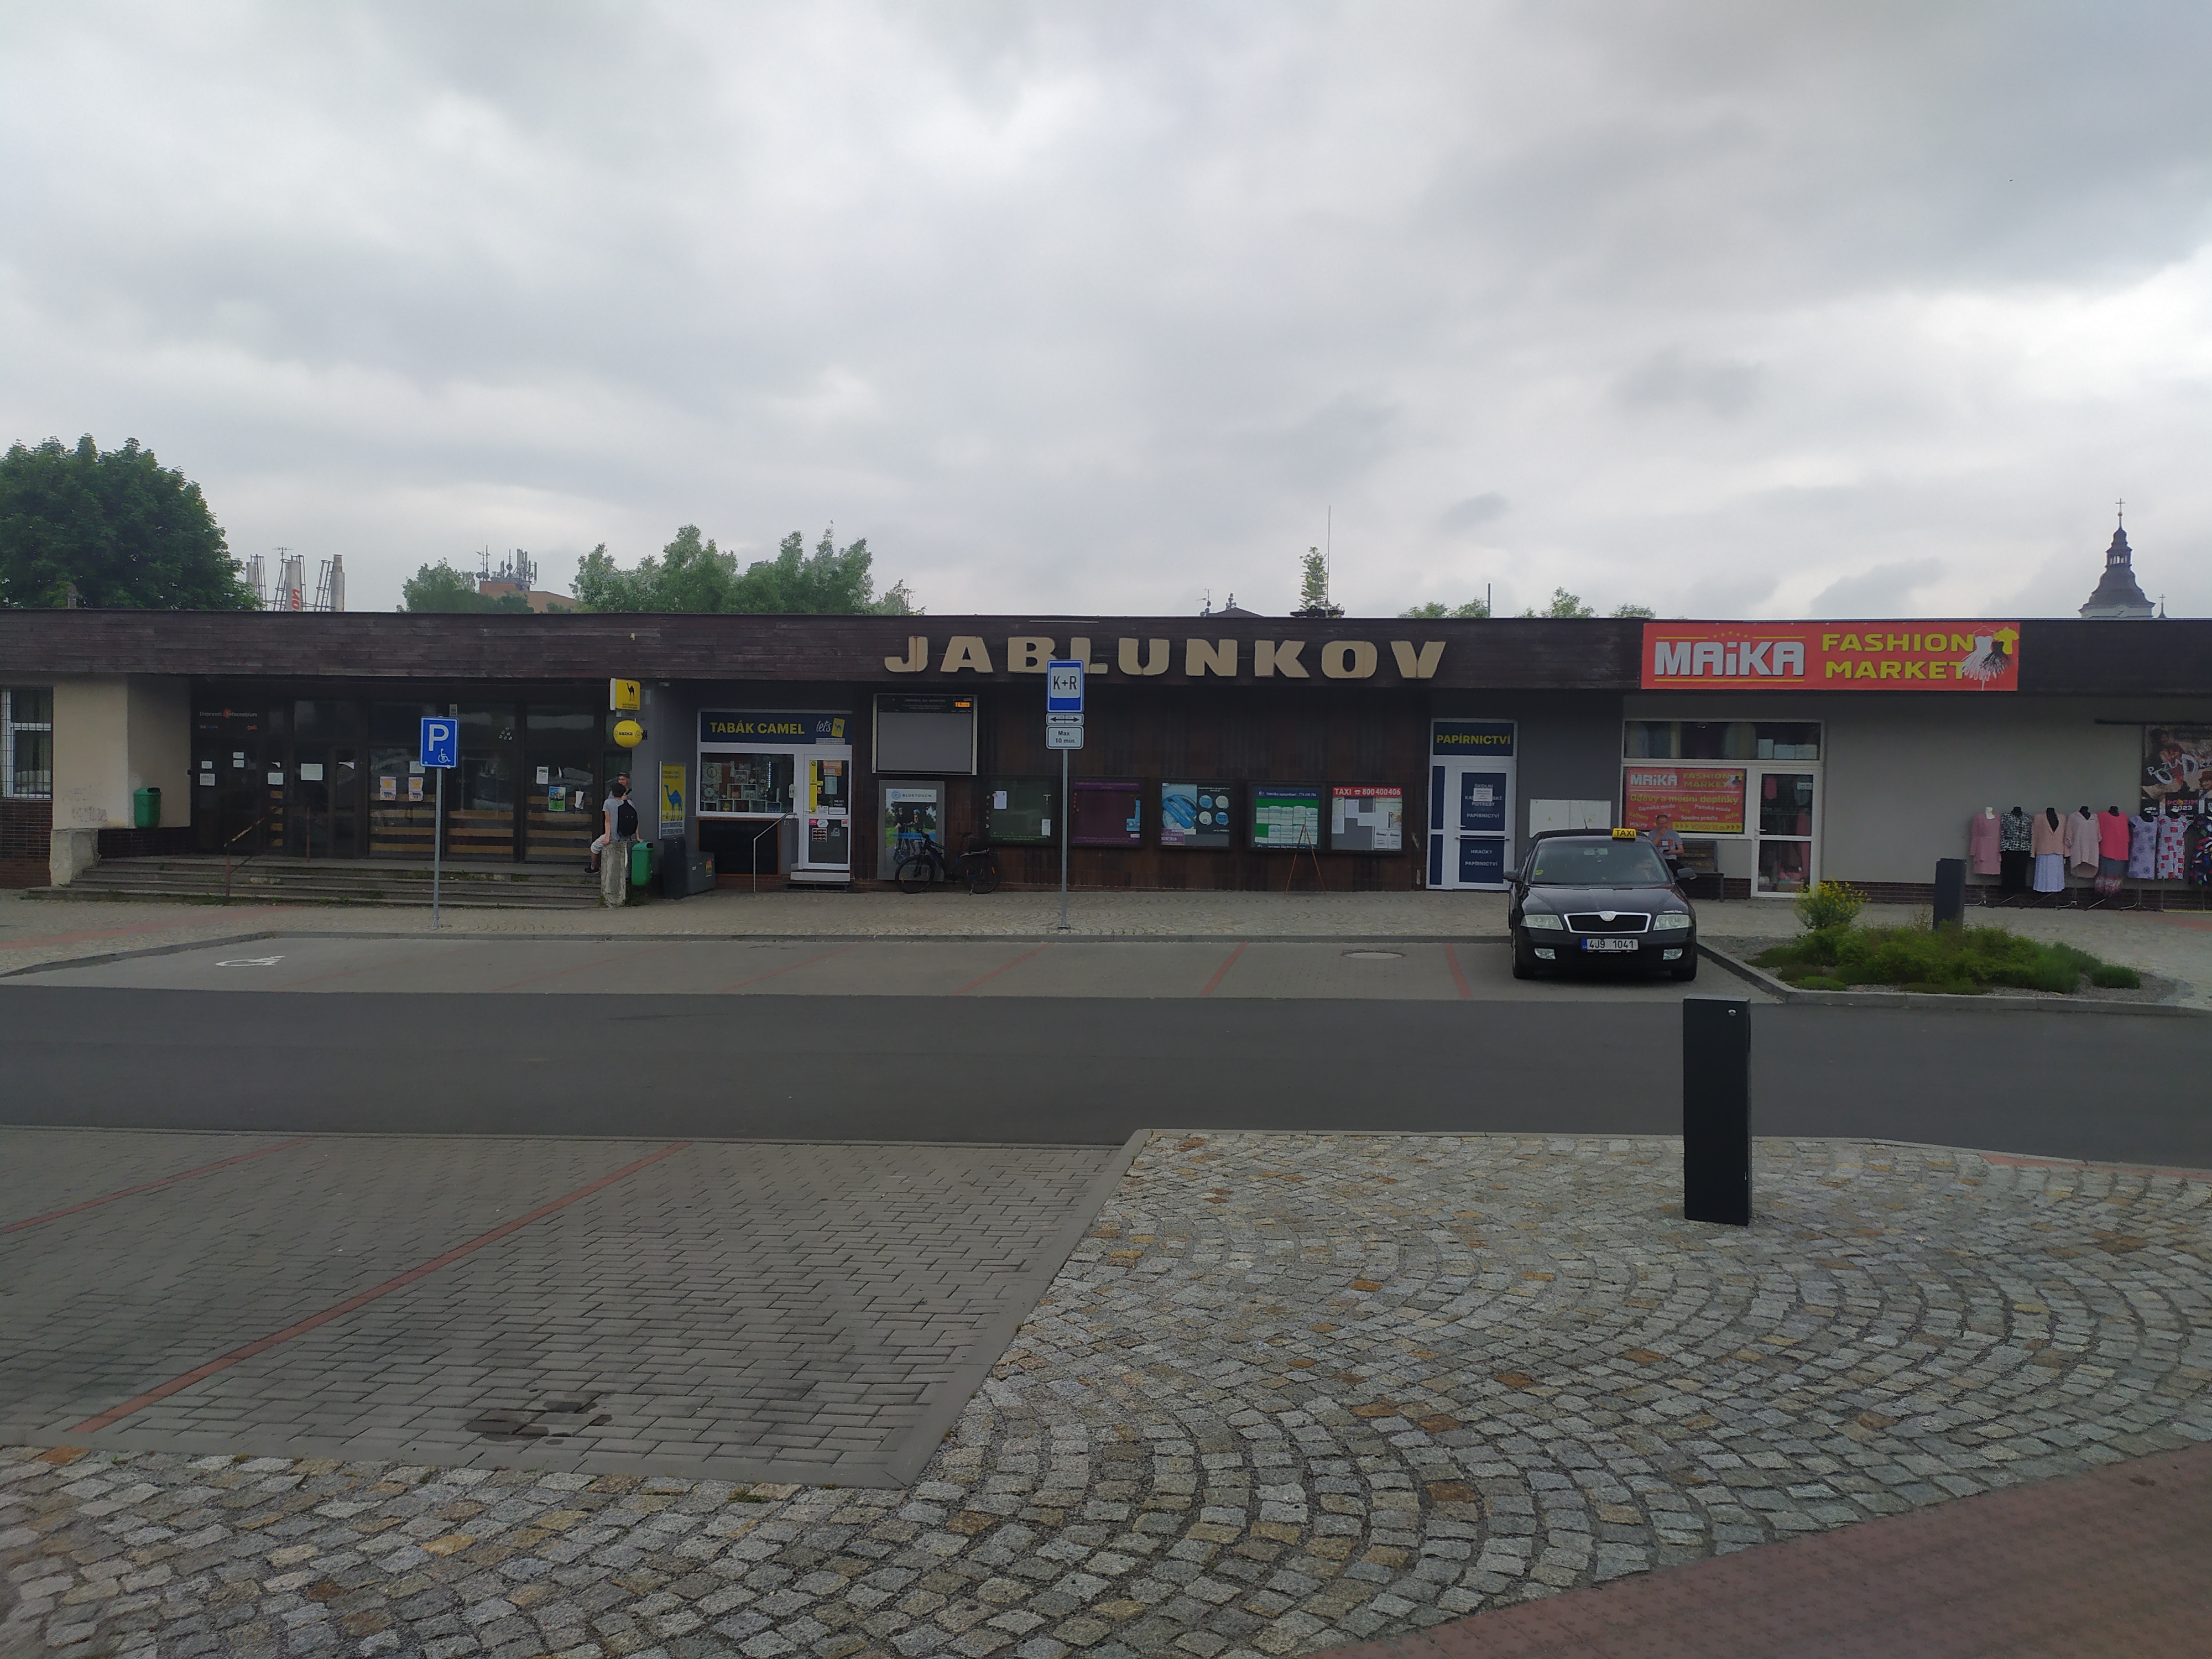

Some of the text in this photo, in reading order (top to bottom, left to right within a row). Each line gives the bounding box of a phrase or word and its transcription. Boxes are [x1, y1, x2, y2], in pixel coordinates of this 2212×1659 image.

[1822, 633, 1974, 652] FASHION
[884, 635, 1447, 680] JABLUNKOV
[1825, 661, 1964, 680] MARKET
[1053, 675, 1077, 690] K+R
[710, 720, 805, 734] TABÁK CAMEL
[429, 724, 449, 751] P
[1436, 733, 1511, 744] PAPÍRNICTVÍ
[1630, 794, 1658, 804] Oděvy
[1700, 795, 1738, 805] doplňky
[1589, 940, 1634, 948] 4J9 1041
